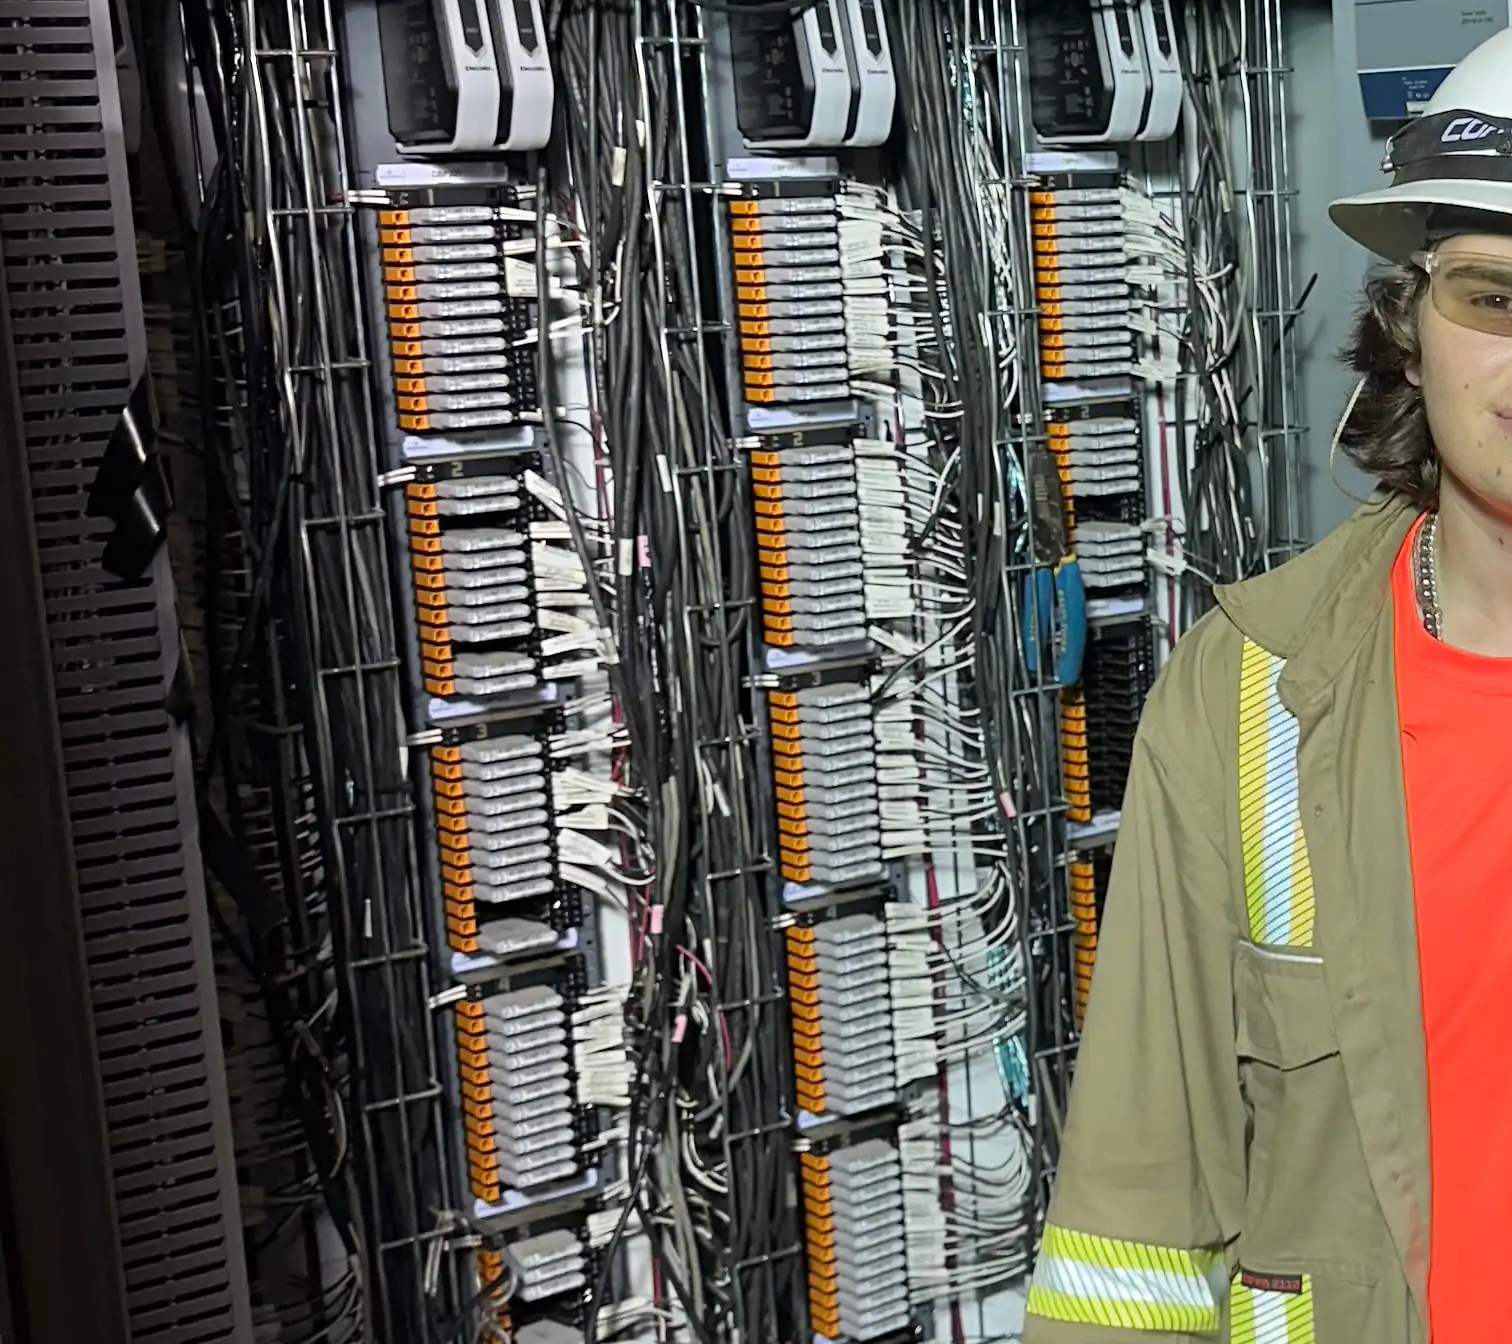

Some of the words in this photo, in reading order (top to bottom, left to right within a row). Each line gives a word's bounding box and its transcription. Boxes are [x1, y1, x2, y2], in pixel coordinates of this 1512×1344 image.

[792, 432, 804, 447] 2
[451, 462, 464, 477] 2
[475, 723, 488, 739] 3
